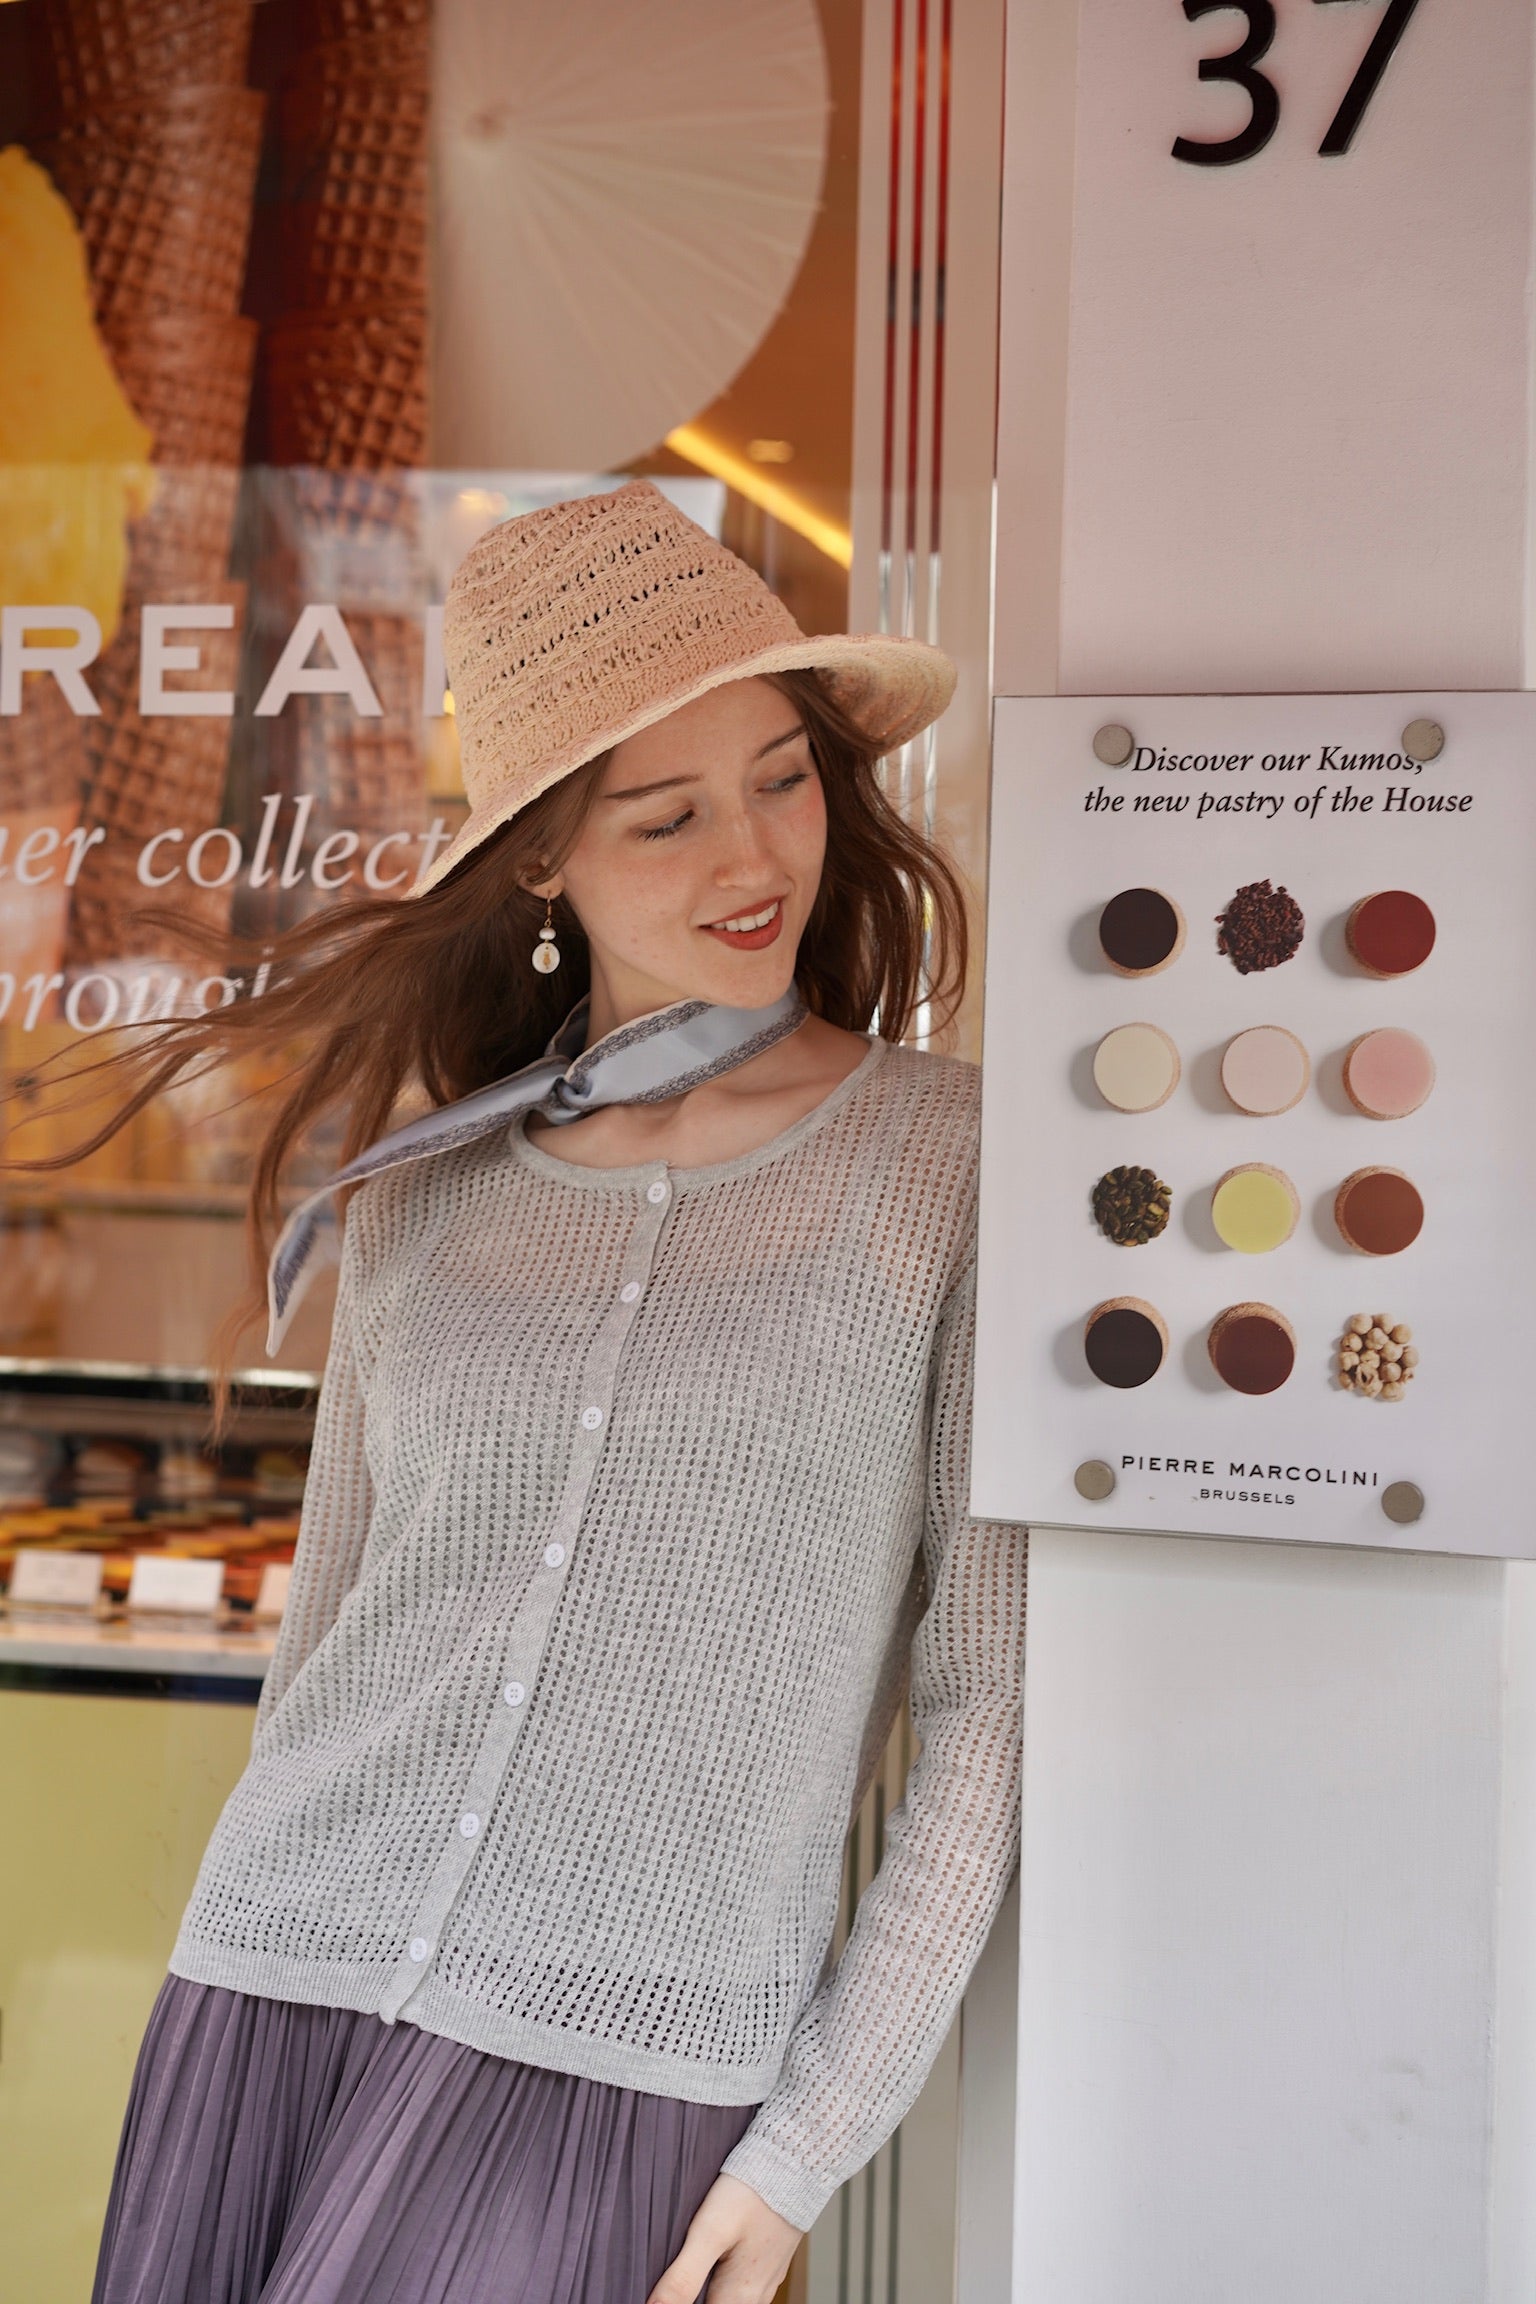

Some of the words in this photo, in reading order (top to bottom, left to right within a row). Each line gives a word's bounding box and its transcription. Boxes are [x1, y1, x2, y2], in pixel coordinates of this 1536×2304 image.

[1170, 0, 1421, 167] 37
[1132, 746, 1255, 772] Discover
[1261, 754, 1311, 772] our
[1316, 745, 1424, 775] Kumos,
[1083, 785, 1126, 812] the
[1133, 795, 1190, 812] new
[1195, 790, 1286, 820] pastry
[1293, 785, 1329, 820] of
[1331, 785, 1375, 813] the
[1381, 786, 1474, 813] House
[0, 826, 106, 887] er
[1121, 1455, 1215, 1475] PIERRE
[1229, 1461, 1379, 1487] MARCOLINI
[1200, 1488, 1296, 1506] BRUSSELS
